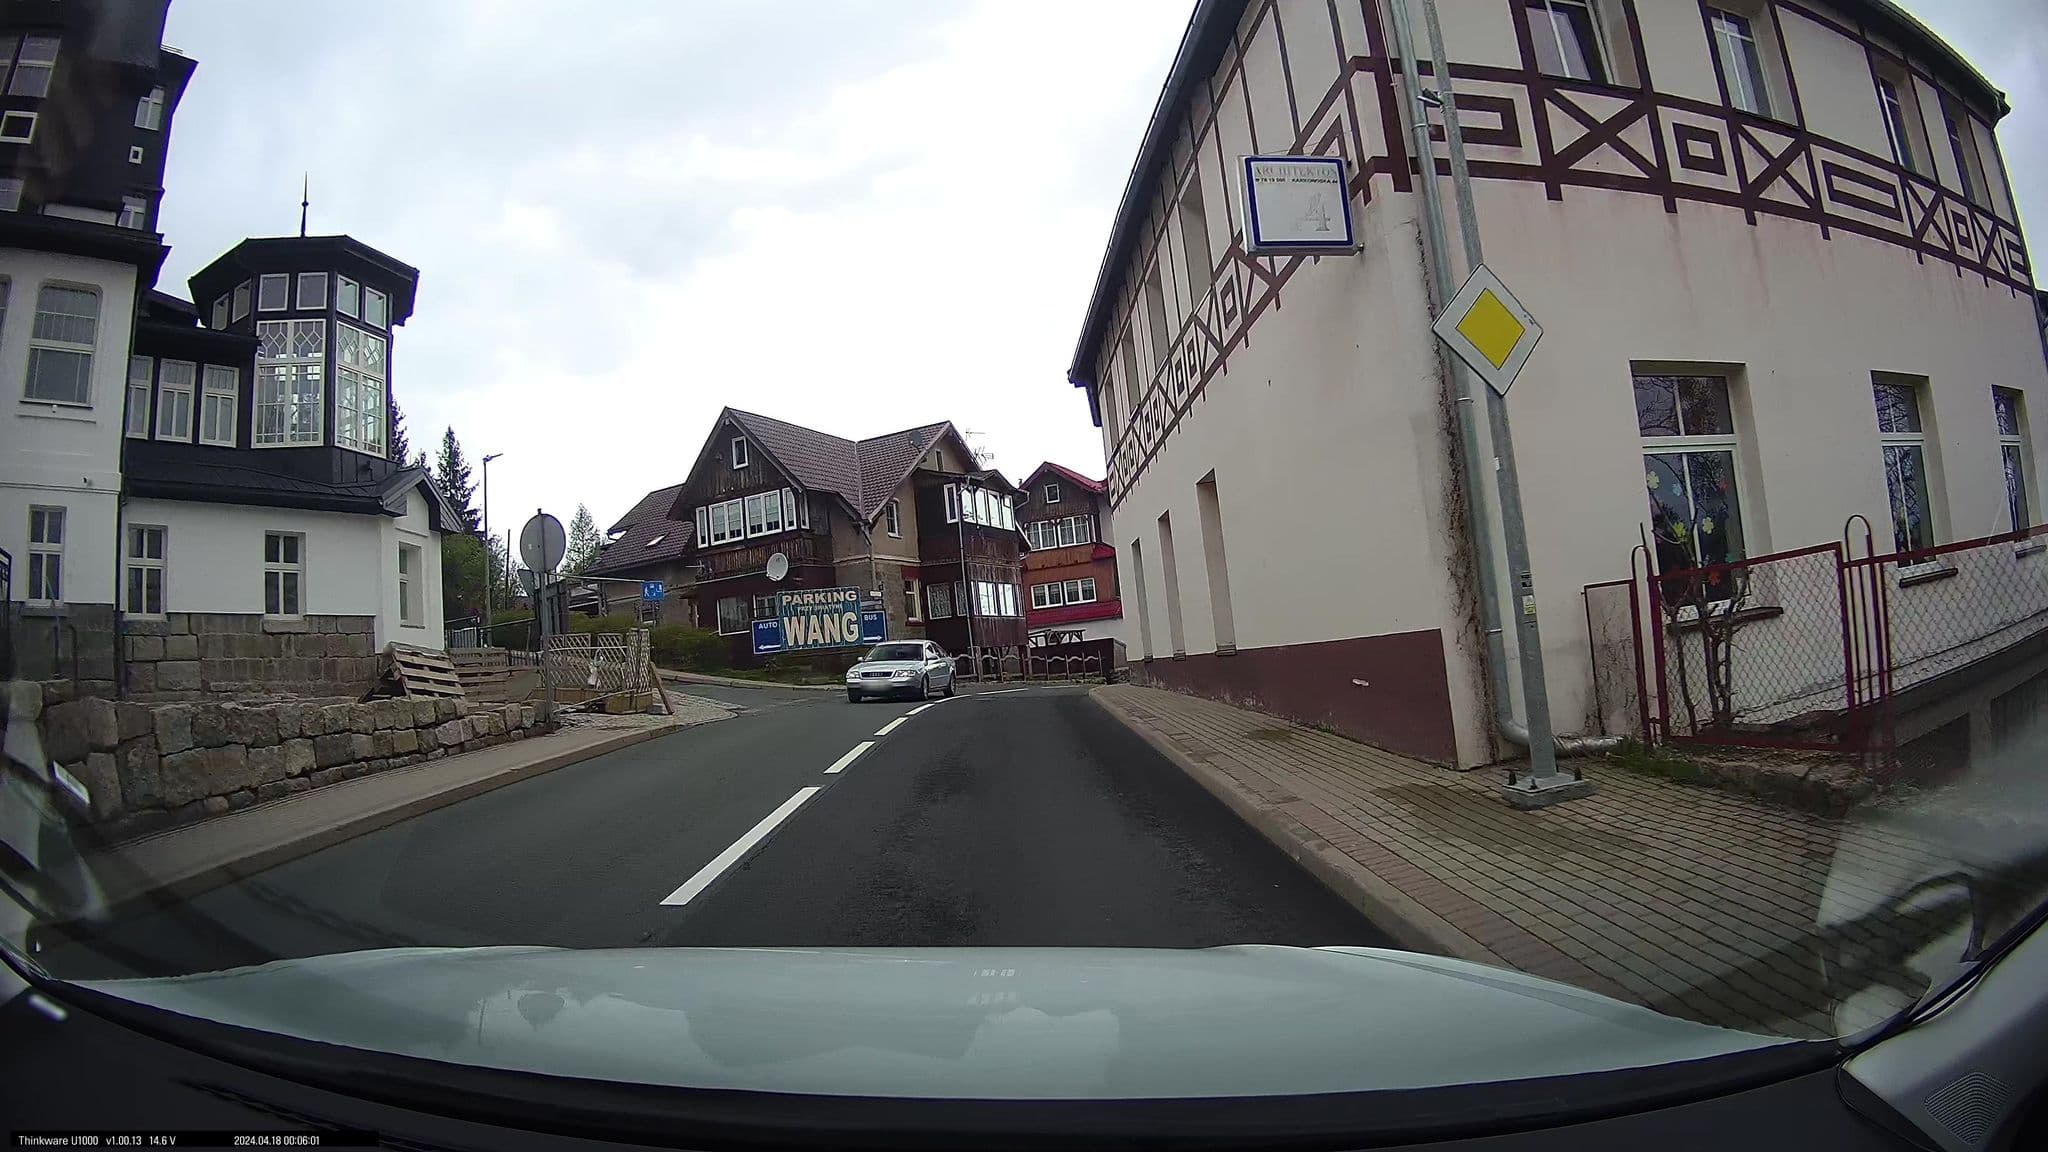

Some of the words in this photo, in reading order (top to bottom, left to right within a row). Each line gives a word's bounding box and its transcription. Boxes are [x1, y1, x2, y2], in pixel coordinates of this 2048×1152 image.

[782, 591, 857, 606] PARKING
[758, 622, 778, 630] AUTO
[783, 612, 859, 647] WANG
